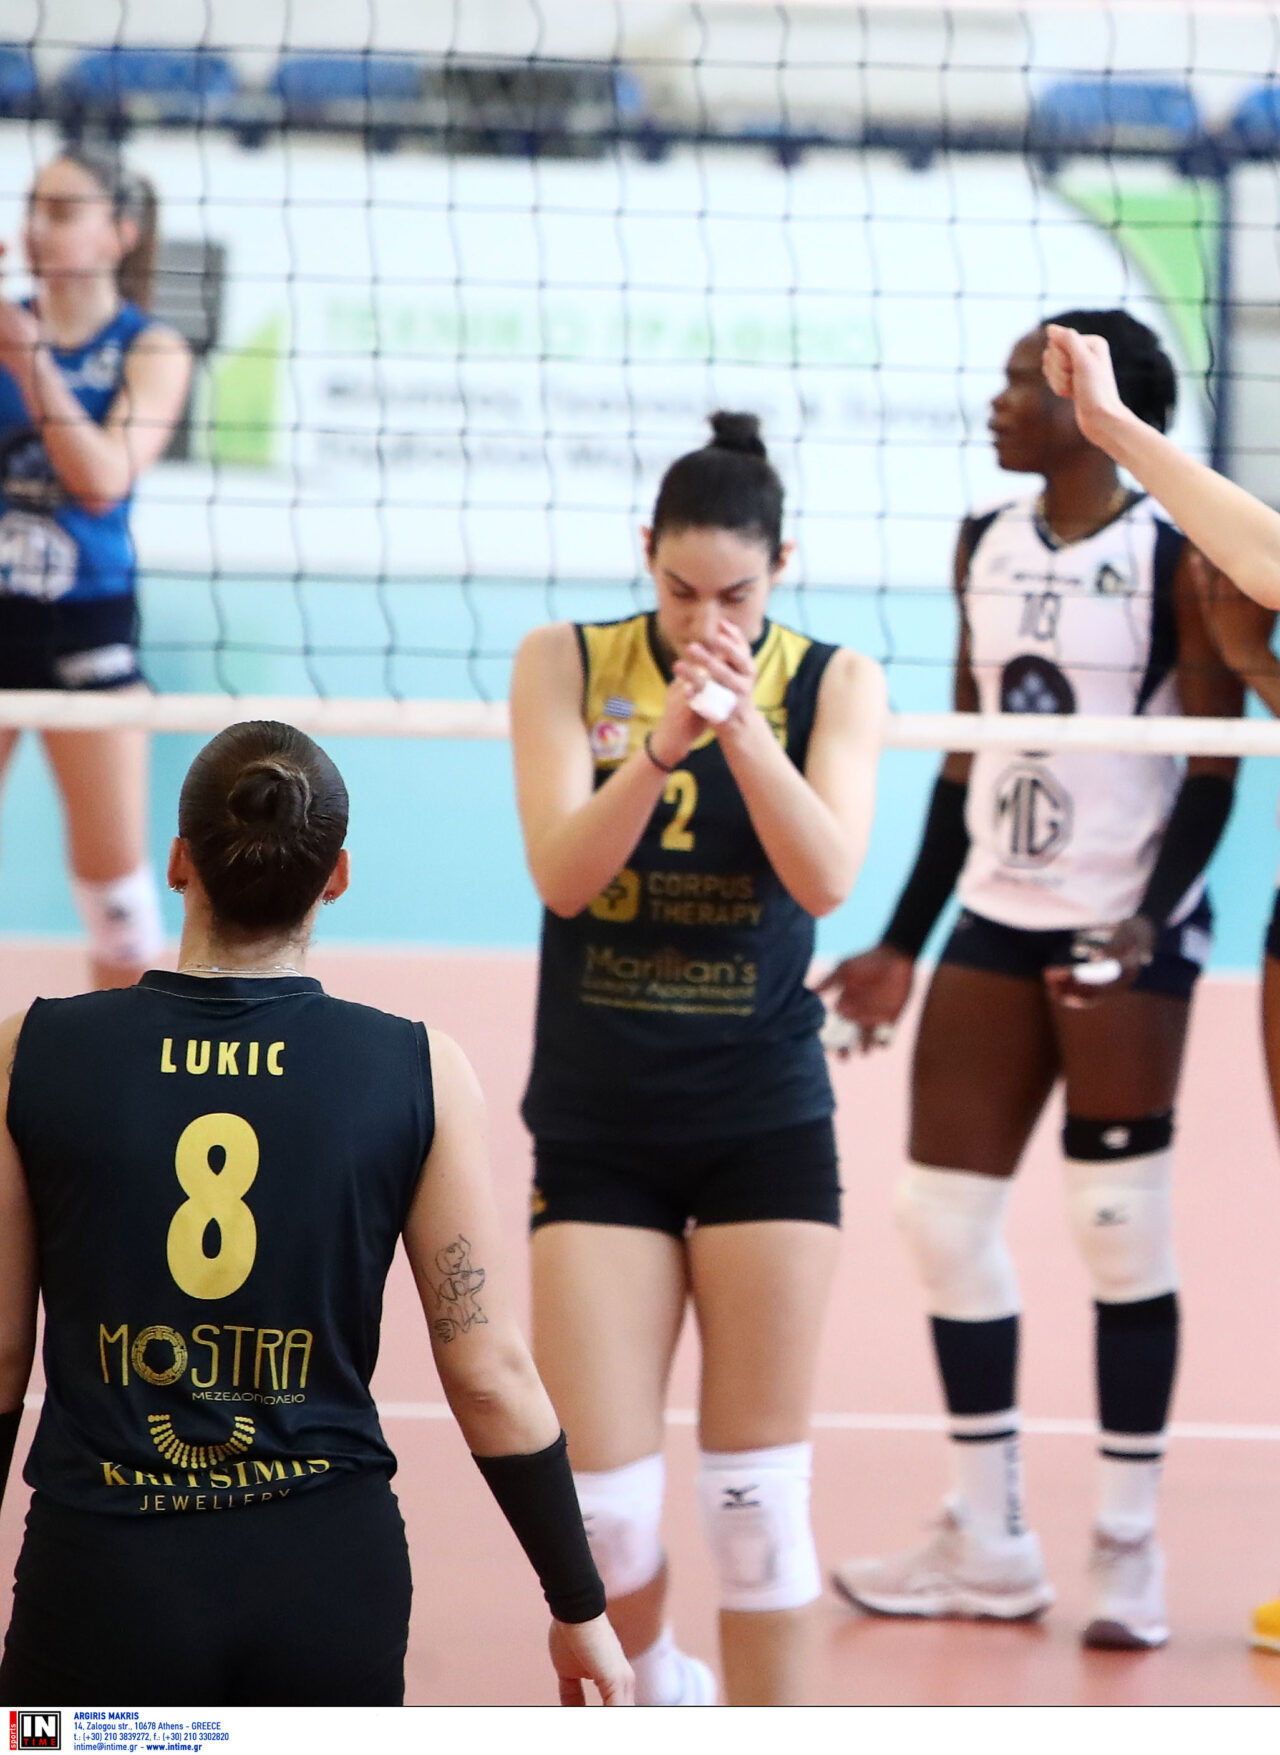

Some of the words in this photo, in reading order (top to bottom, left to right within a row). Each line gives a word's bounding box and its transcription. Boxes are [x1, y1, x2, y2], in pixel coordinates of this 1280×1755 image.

[661, 769, 698, 851] 2
[160, 1038, 286, 1076] LUKIC
[167, 1112, 260, 1300] 8
[99, 1323, 314, 1390] MOSTRA
